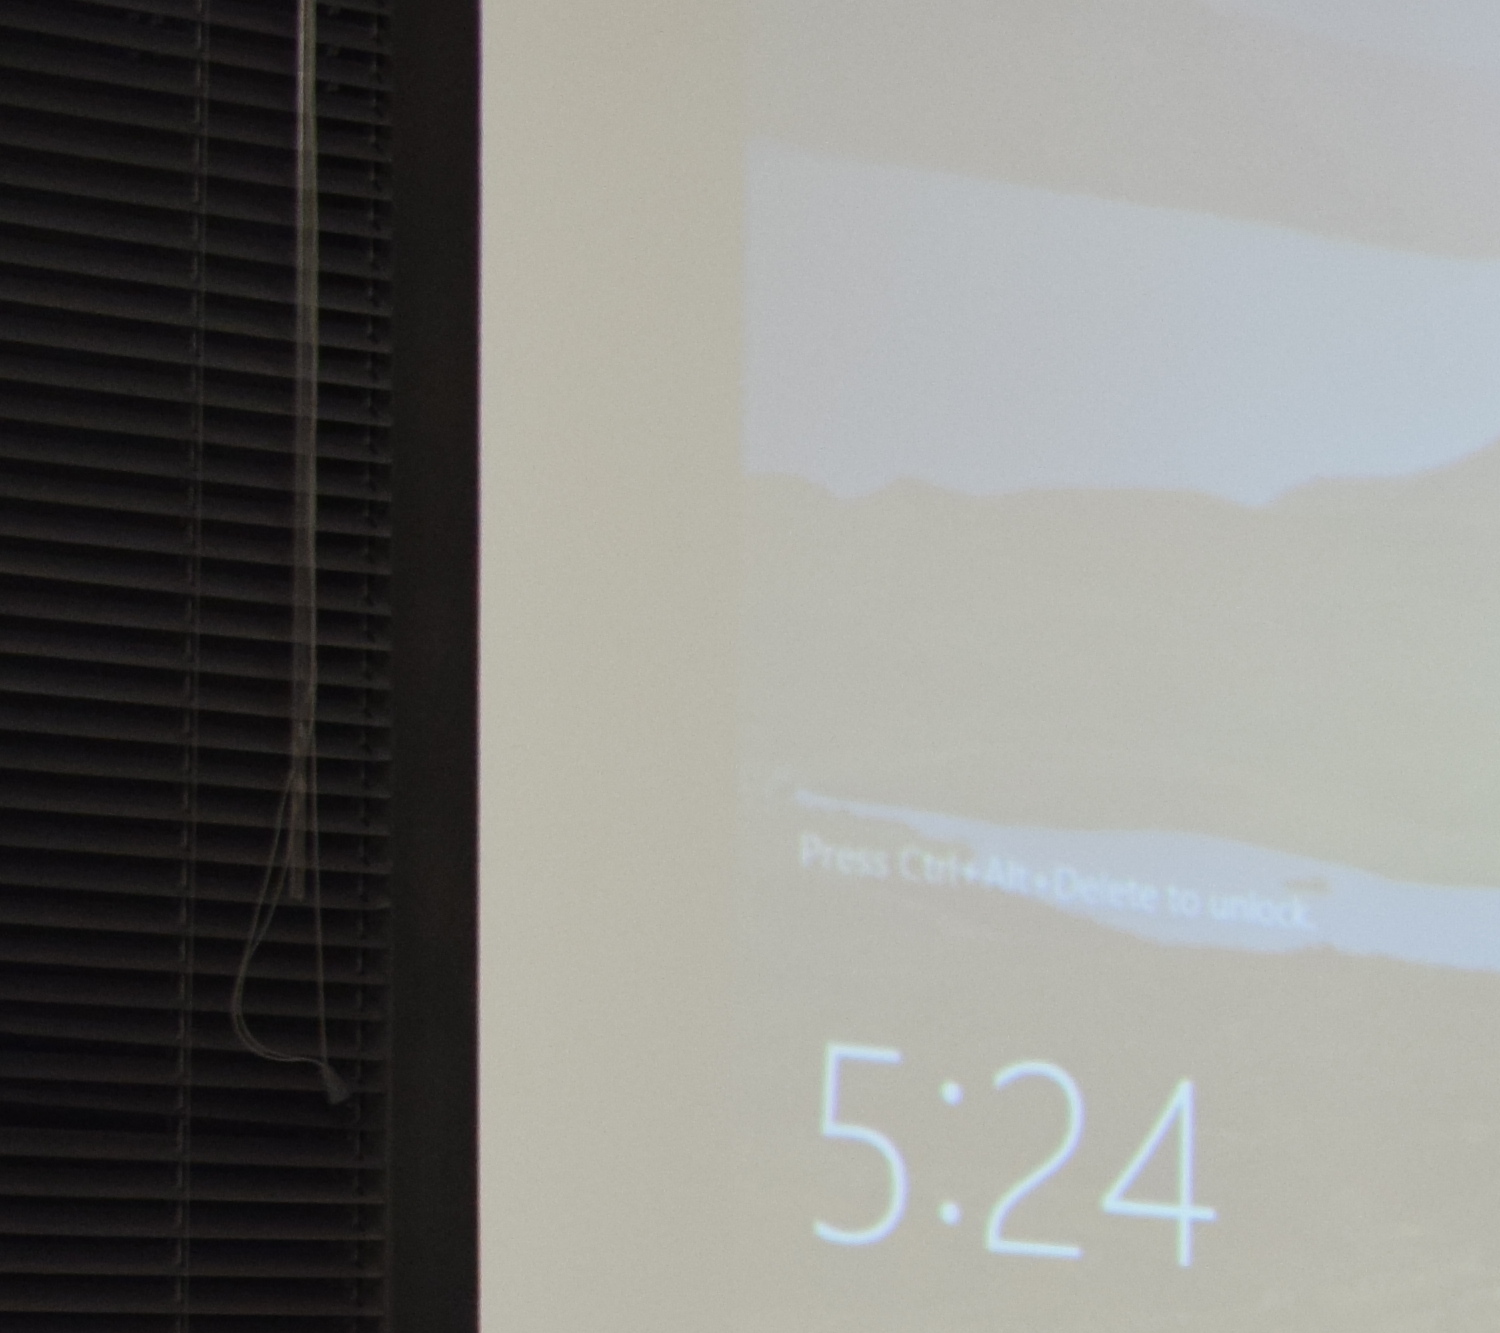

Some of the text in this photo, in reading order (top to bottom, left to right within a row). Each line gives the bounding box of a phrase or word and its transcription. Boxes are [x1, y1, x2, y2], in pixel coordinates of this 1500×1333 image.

[800, 833, 889, 879] Press
[900, 846, 1158, 914] Ctrl+Alt+Delete
[1168, 884, 1201, 917] to
[812, 1042, 1216, 1267] 5:24
